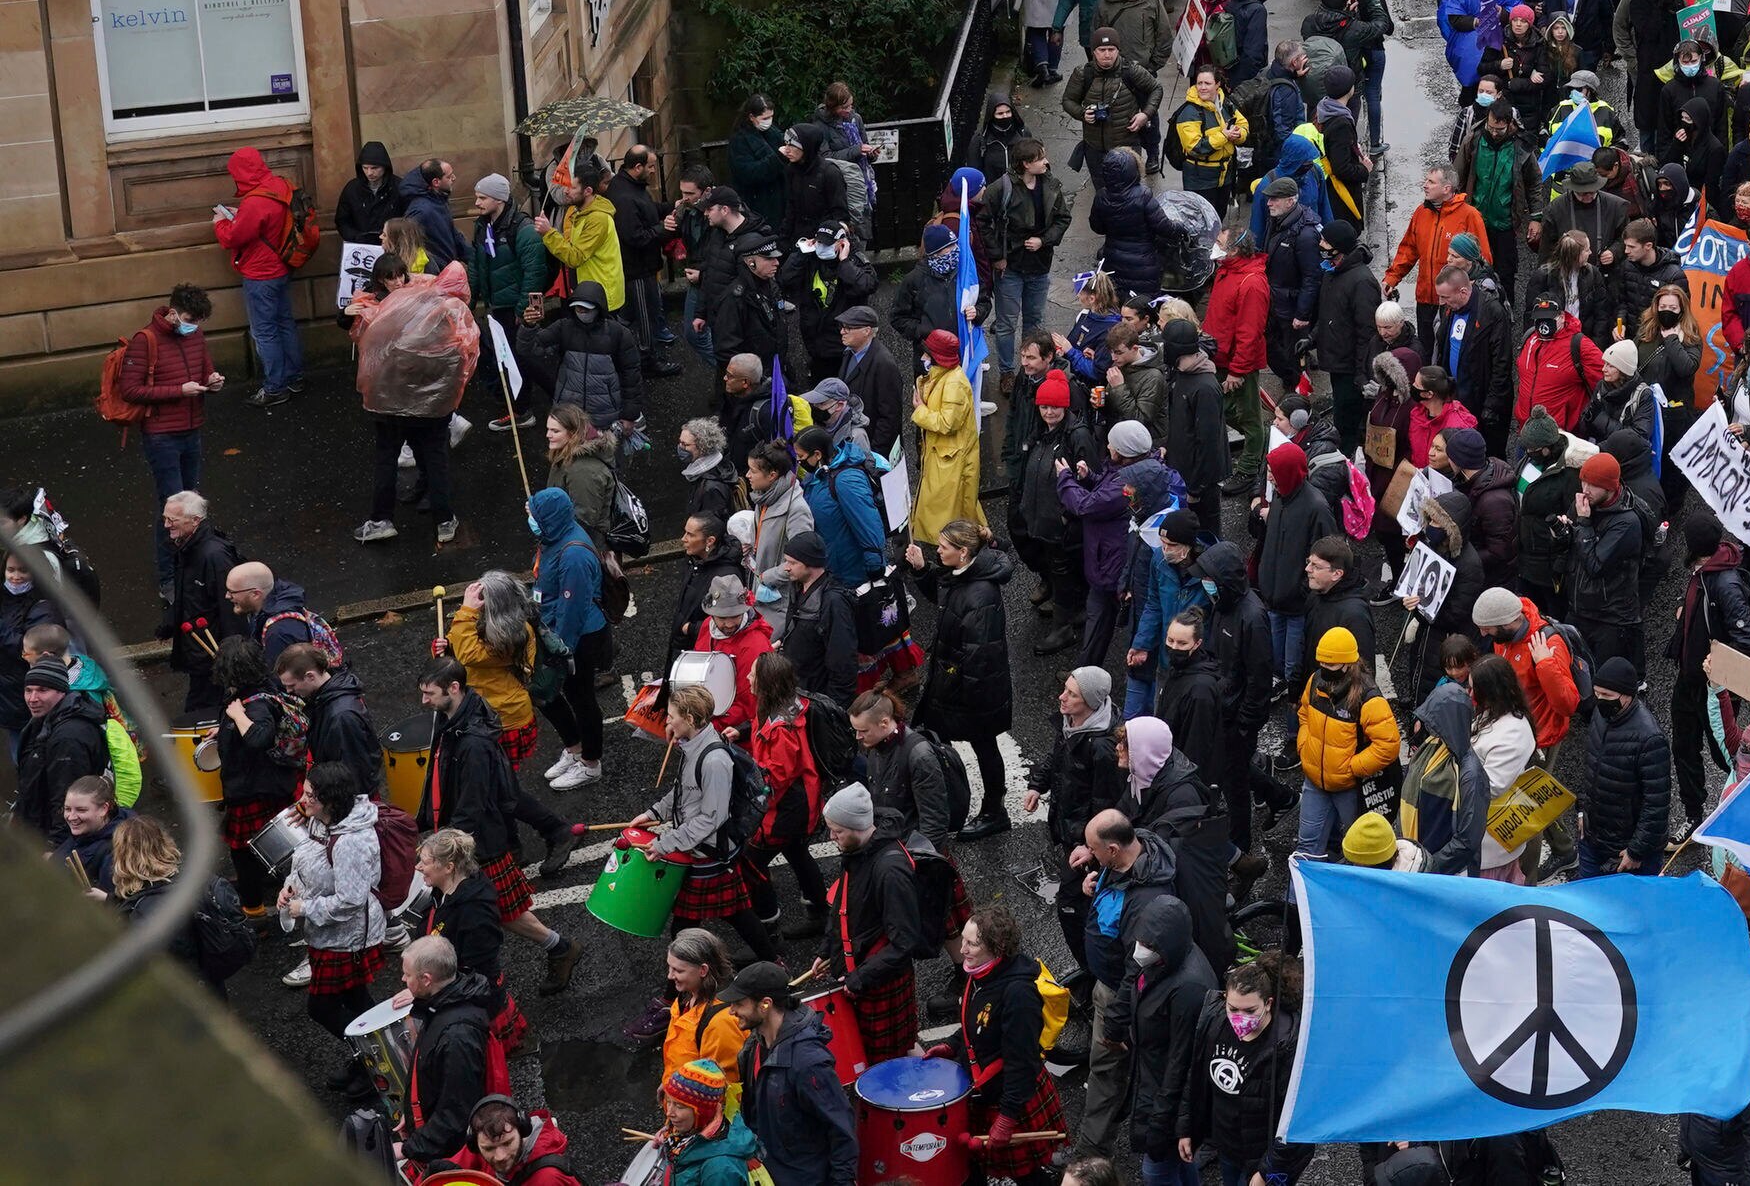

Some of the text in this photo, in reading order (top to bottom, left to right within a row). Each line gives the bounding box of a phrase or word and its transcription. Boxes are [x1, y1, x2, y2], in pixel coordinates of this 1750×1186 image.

[112, 9, 187, 29] kelvin
[1682, 7, 1711, 29] CLIMATE
[1361, 780, 1377, 796] USE
[1364, 786, 1396, 809] PLASTIC
